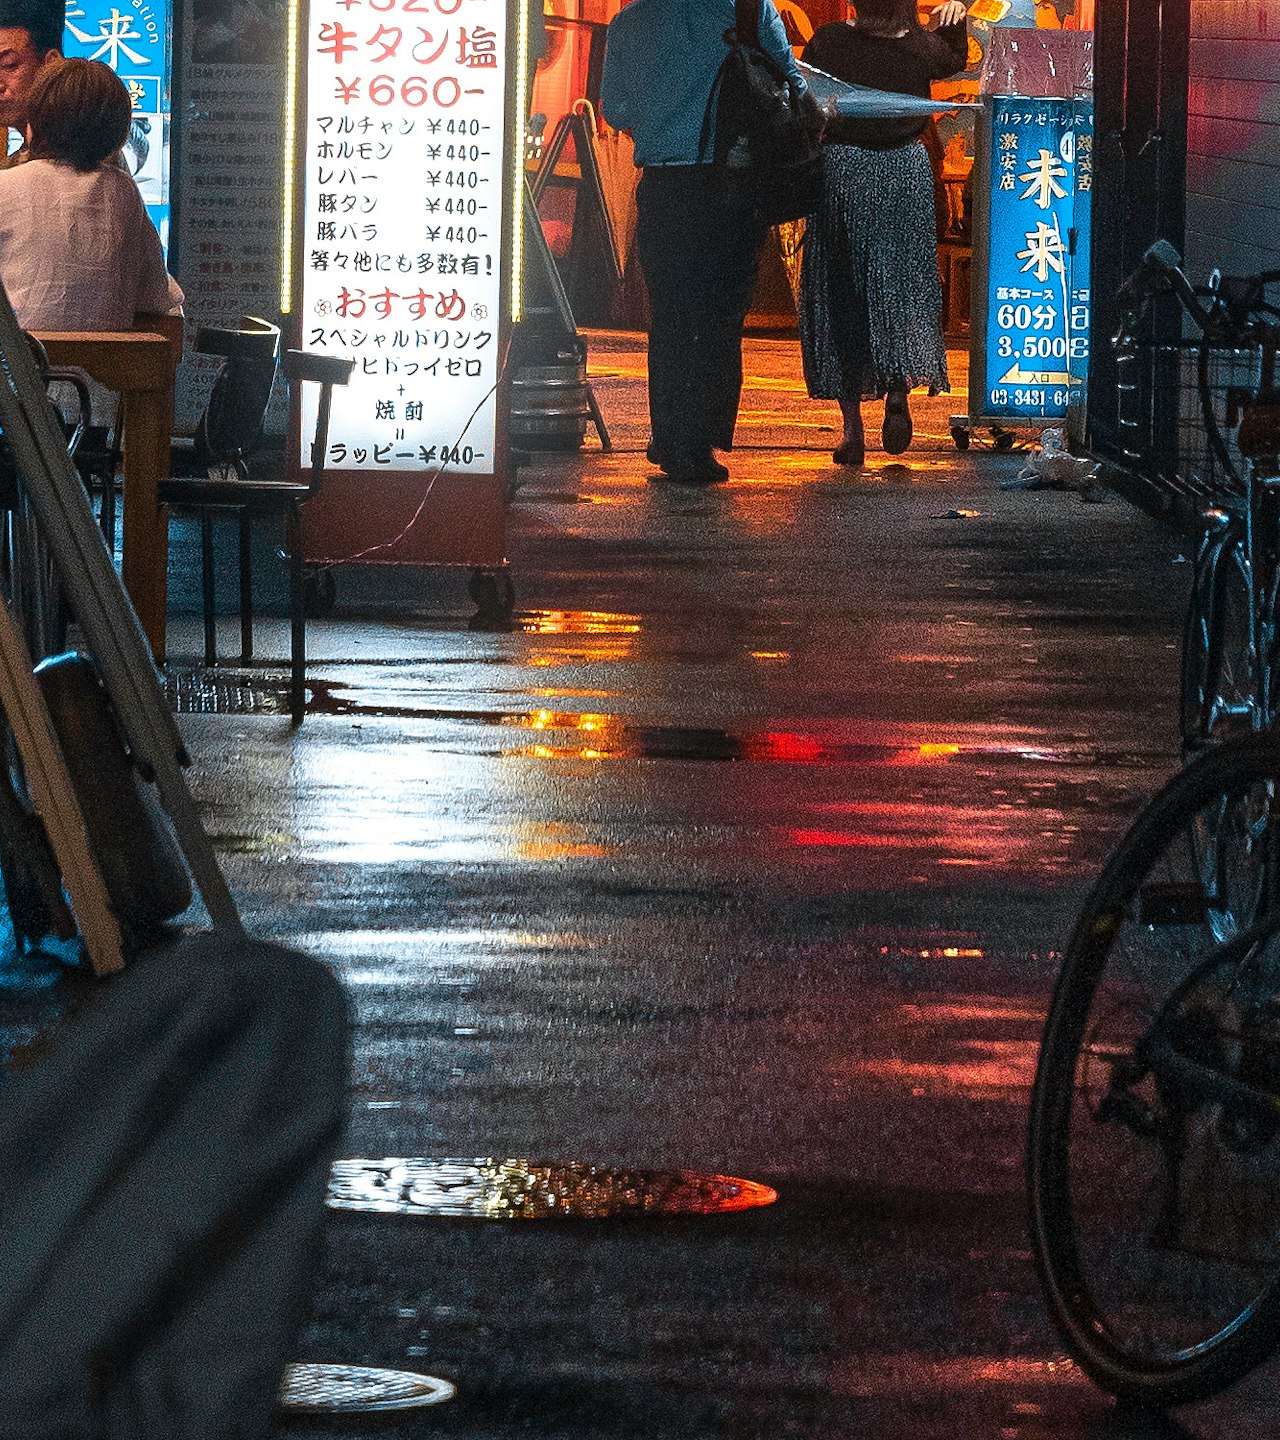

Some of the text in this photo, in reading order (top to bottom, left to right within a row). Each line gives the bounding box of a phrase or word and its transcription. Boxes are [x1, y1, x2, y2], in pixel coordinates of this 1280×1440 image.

[317, 22, 497, 68] 牛タン塩
[316, 115, 415, 135] マルチャン
[316, 141, 392, 160] ホルモン
[317, 166, 378, 185] レバー
[317, 193, 378, 213] 豚タン
[1015, 148, 1069, 283] 未来
[317, 221, 378, 241] 豚バラ
[335, 285, 466, 321] おすすめ
